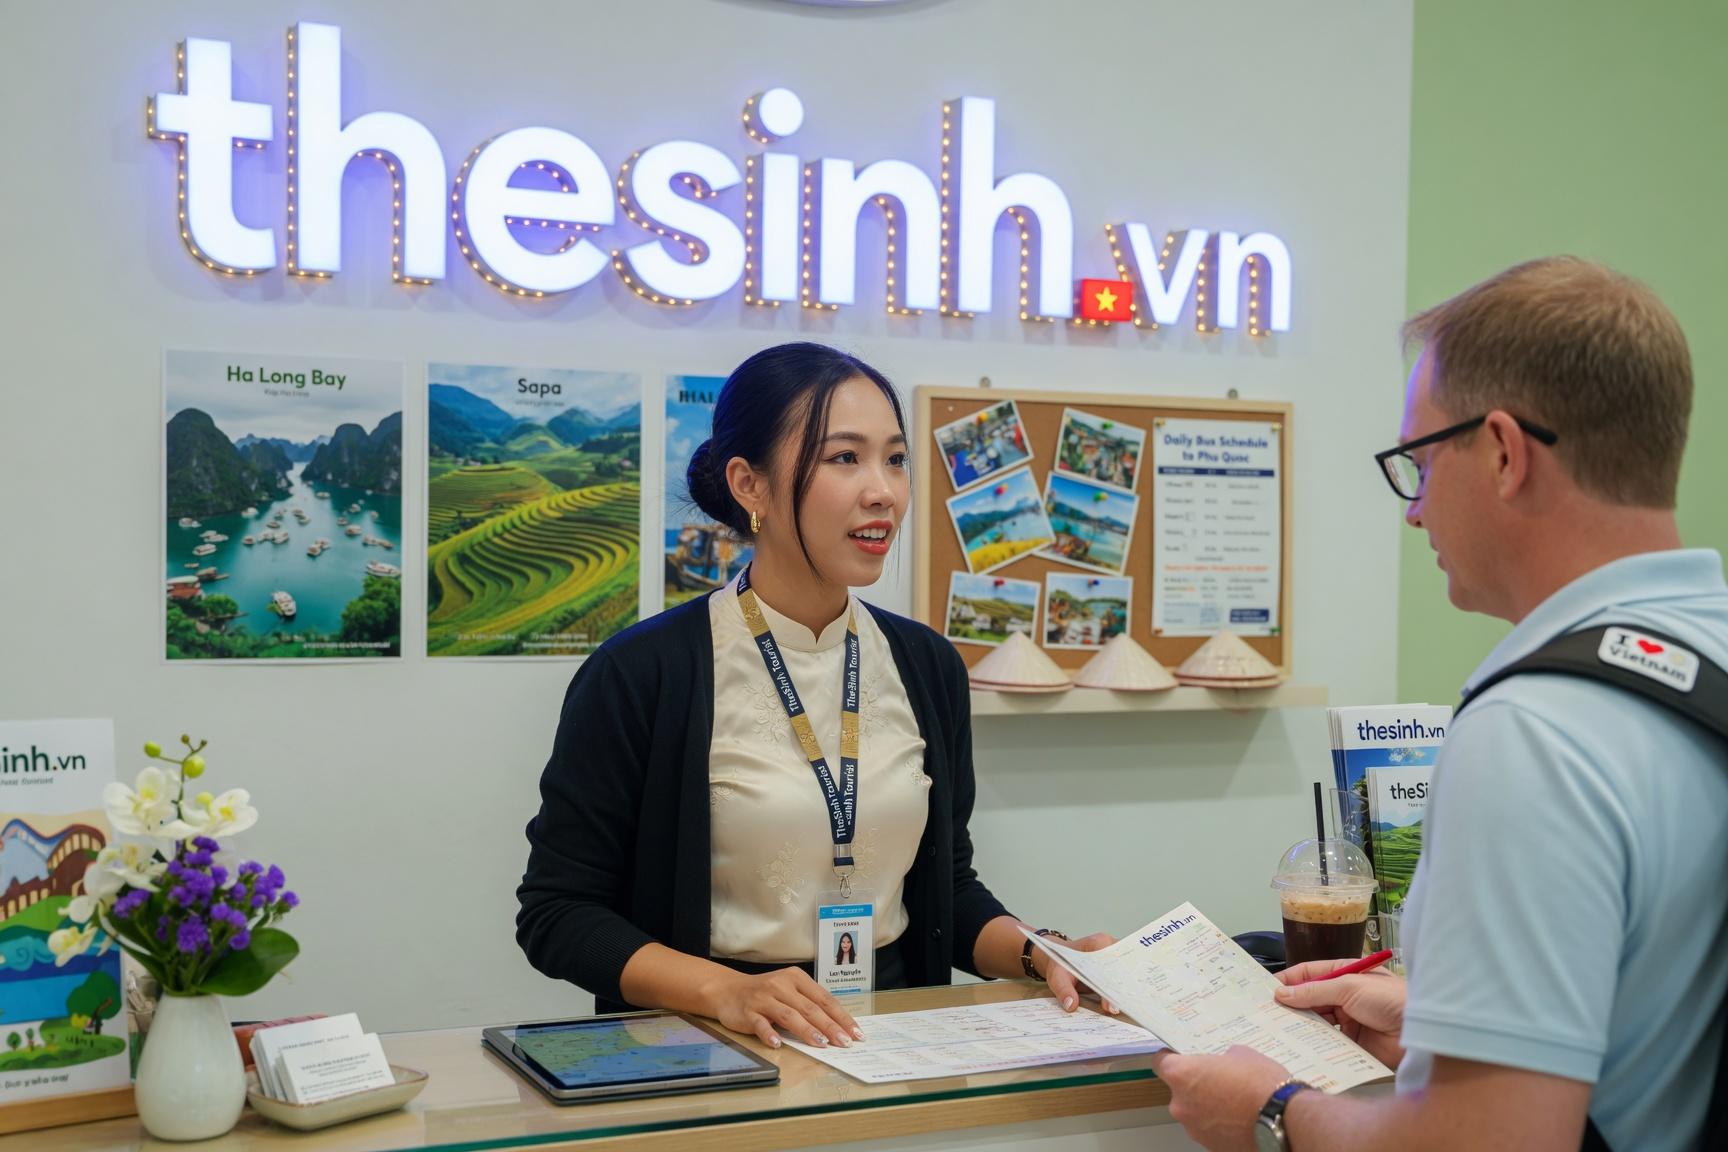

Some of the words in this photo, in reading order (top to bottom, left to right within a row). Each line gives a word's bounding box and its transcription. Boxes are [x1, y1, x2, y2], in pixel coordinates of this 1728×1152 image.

[227, 365, 253, 382] Ha
[260, 367, 306, 389] Long
[312, 369, 346, 391] Bay
[517, 378, 562, 398] Sapa
[1164, 434, 1192, 447] Daily
[1196, 436, 1216, 447] Bus
[1219, 436, 1268, 449] Schedule
[1616, 633, 1629, 646] I
[1610, 645, 1687, 683] Vietnam
[1357, 718, 1445, 741] thesinh.vn
[0, 745, 86, 774] inh.vn
[1389, 782, 1429, 800] theSi
